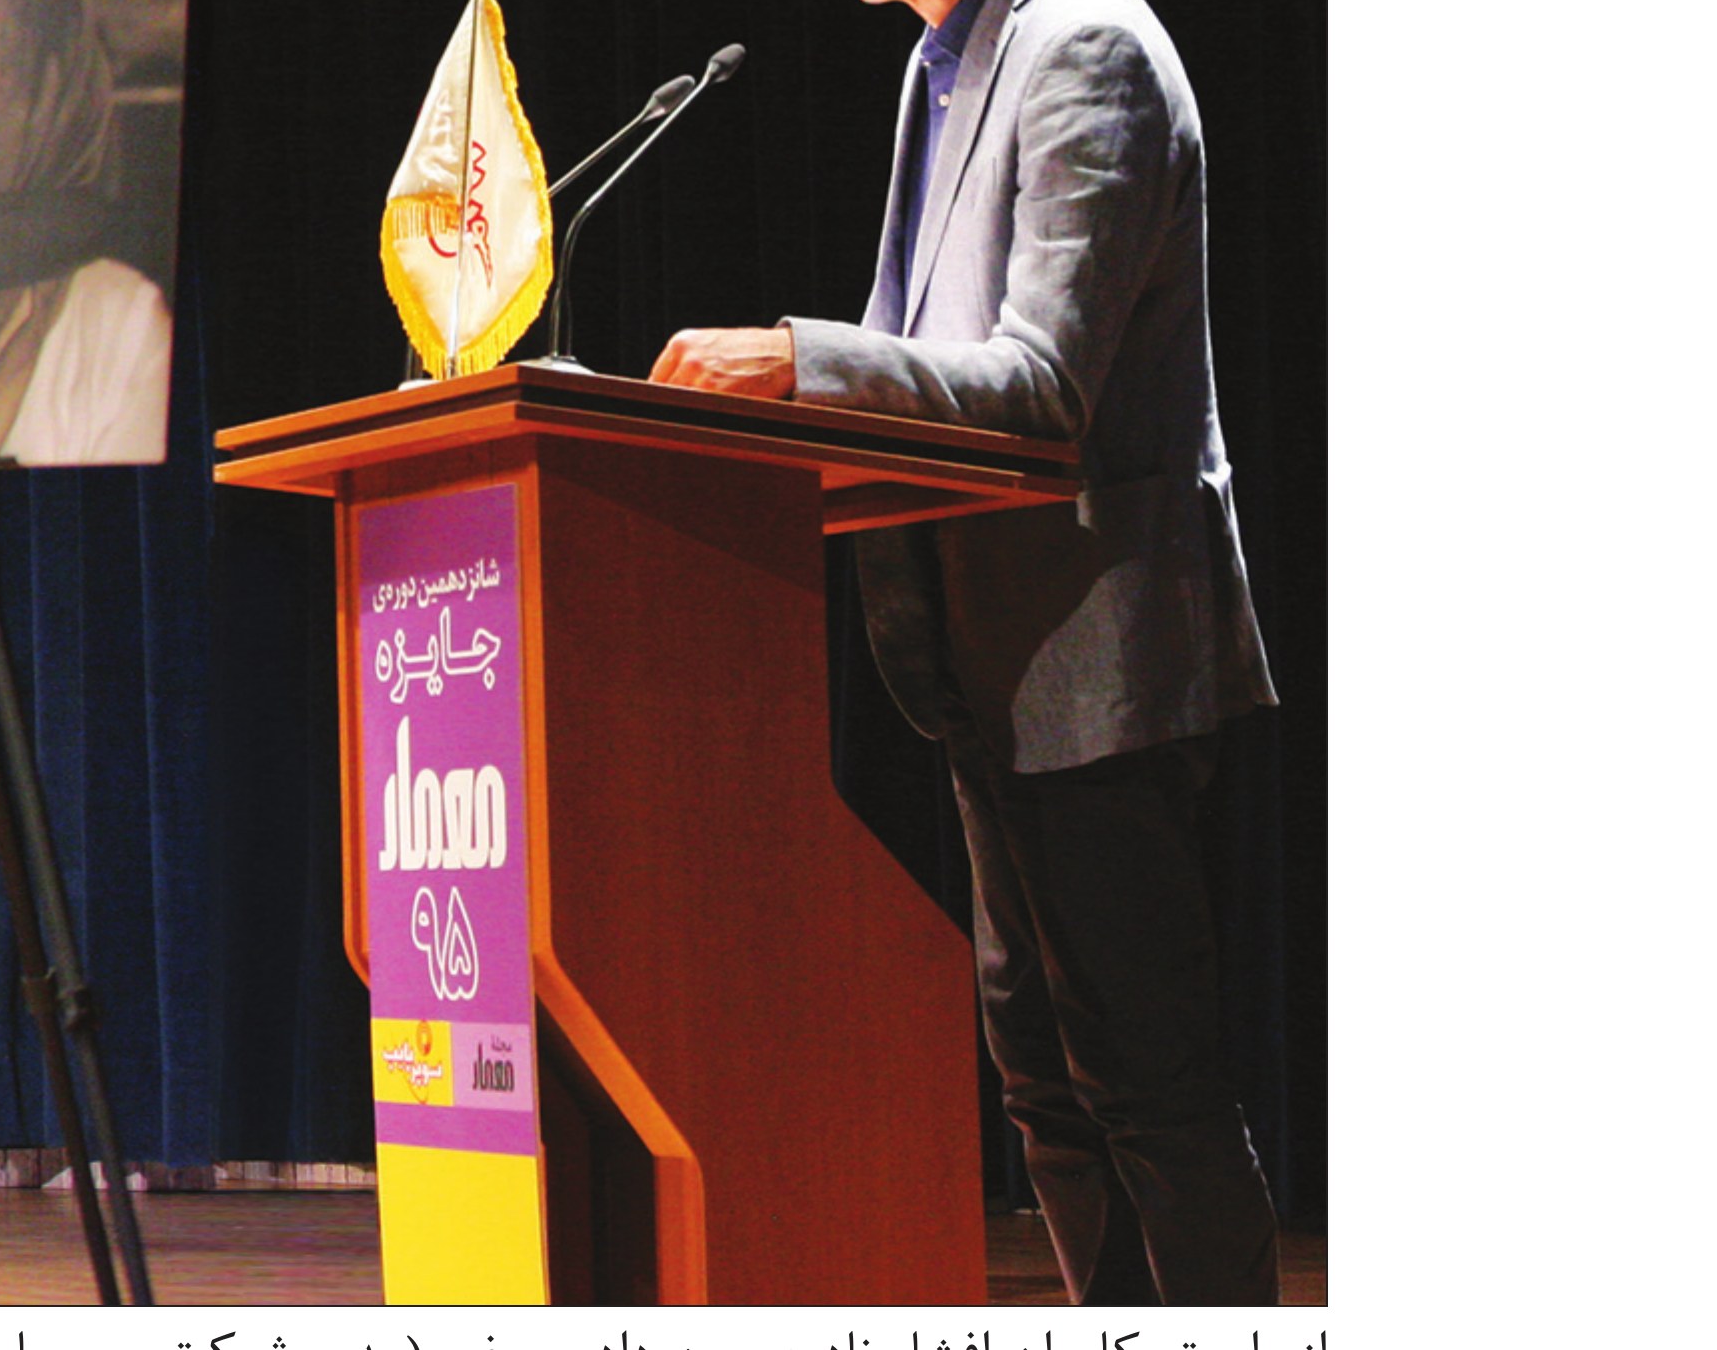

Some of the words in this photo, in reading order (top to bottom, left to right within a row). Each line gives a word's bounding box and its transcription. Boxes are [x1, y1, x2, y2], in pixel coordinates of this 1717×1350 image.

[418, 557, 501, 609] شانزدهمین
[376, 606, 502, 704] جایزه
[378, 715, 508, 871] معمار
[411, 885, 480, 1001] ۹۵
[472, 1041, 516, 1093] معمار
